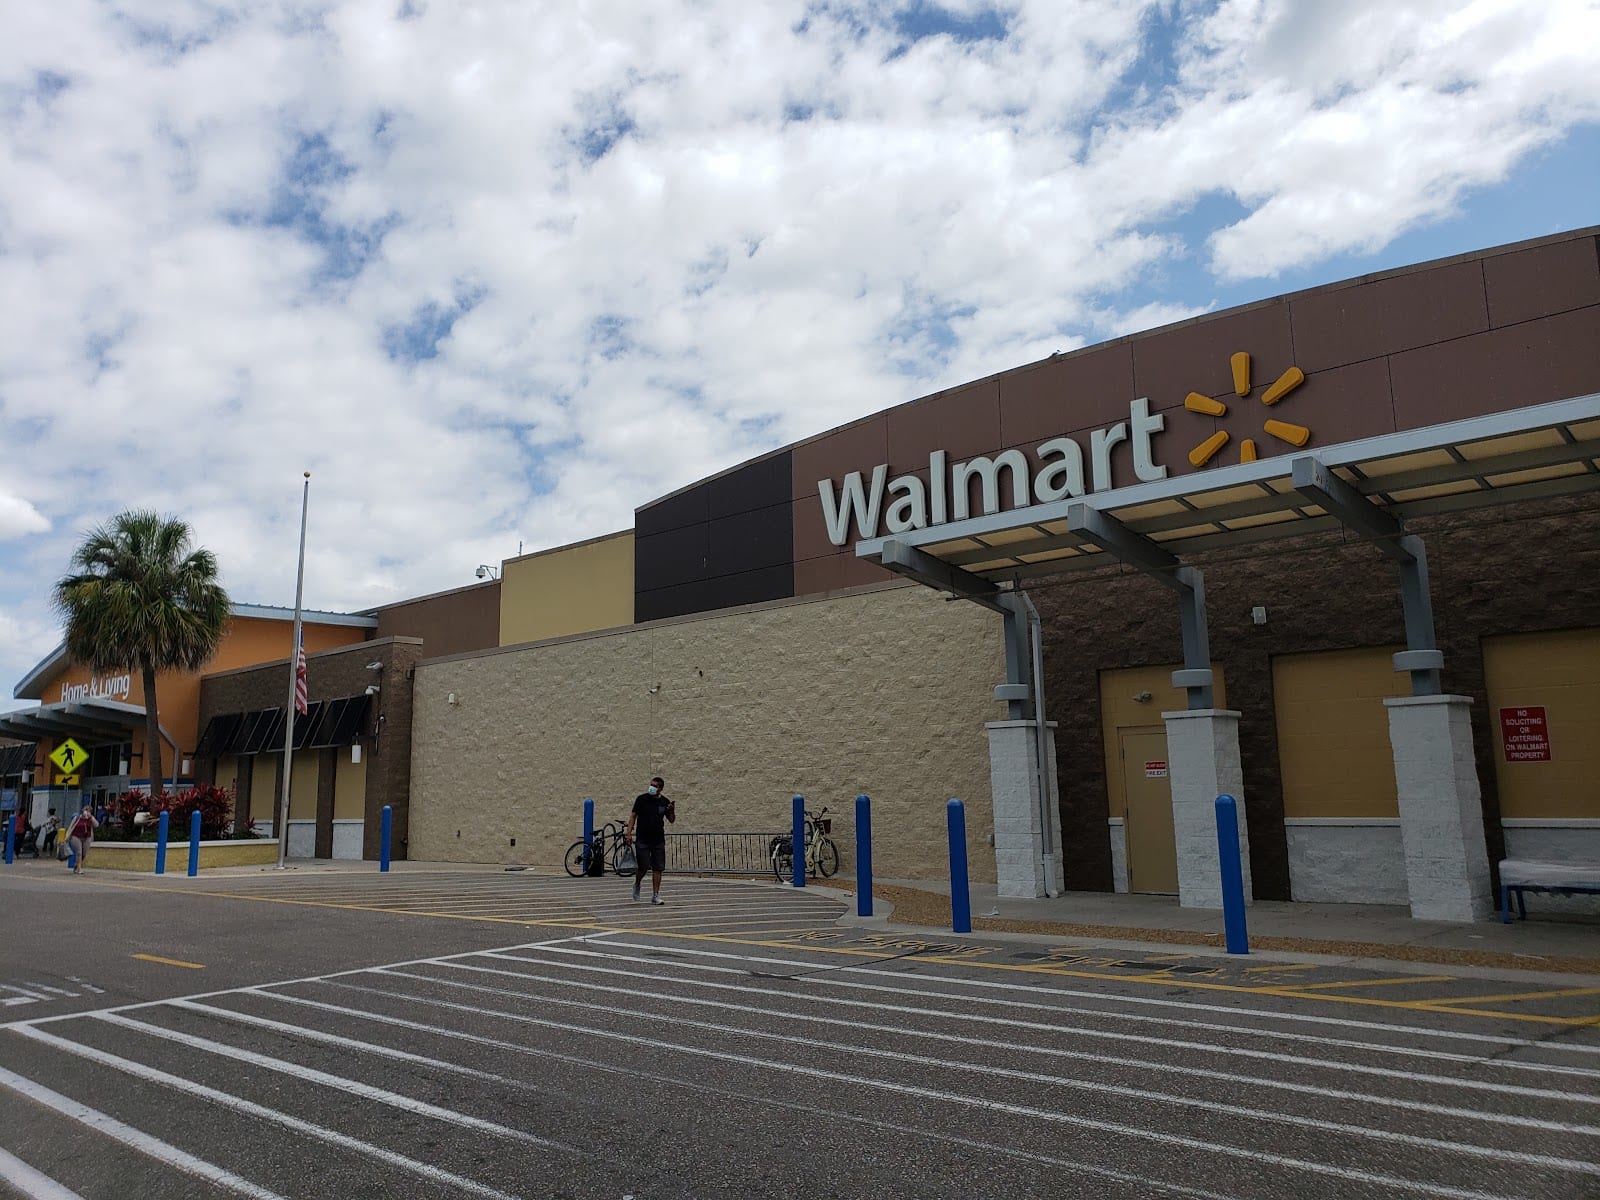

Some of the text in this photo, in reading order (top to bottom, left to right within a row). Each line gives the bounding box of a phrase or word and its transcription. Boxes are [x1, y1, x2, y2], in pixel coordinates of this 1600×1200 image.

[818, 397, 1167, 546] Walmart
[61, 671, 130, 702] Home & Living
